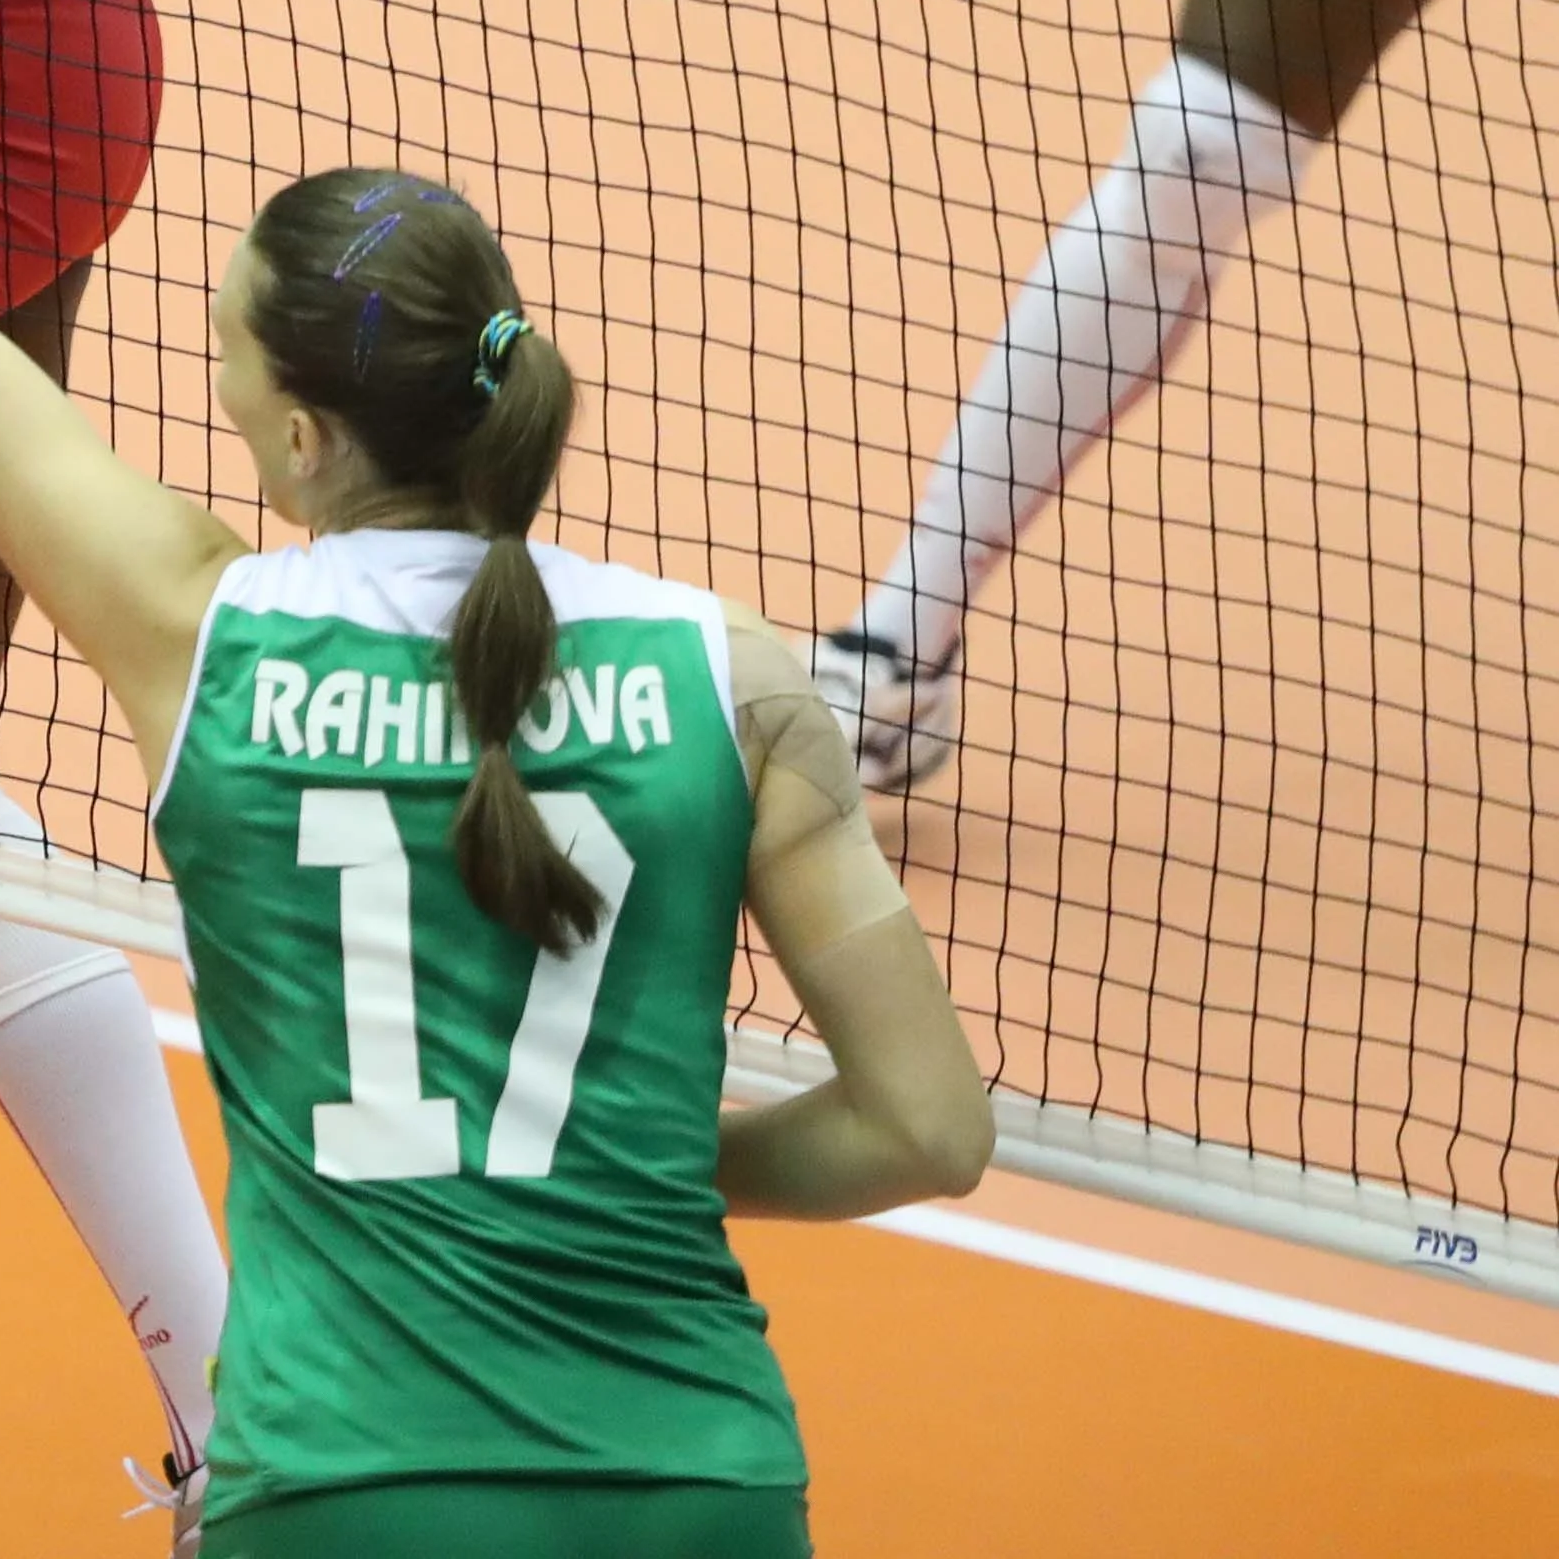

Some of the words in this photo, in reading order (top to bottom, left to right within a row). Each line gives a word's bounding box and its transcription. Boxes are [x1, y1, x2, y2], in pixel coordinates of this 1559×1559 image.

[251, 657, 673, 768] RAHIOVA
[297, 786, 637, 1181] 17
[1415, 1226, 1478, 1264] FIVB
